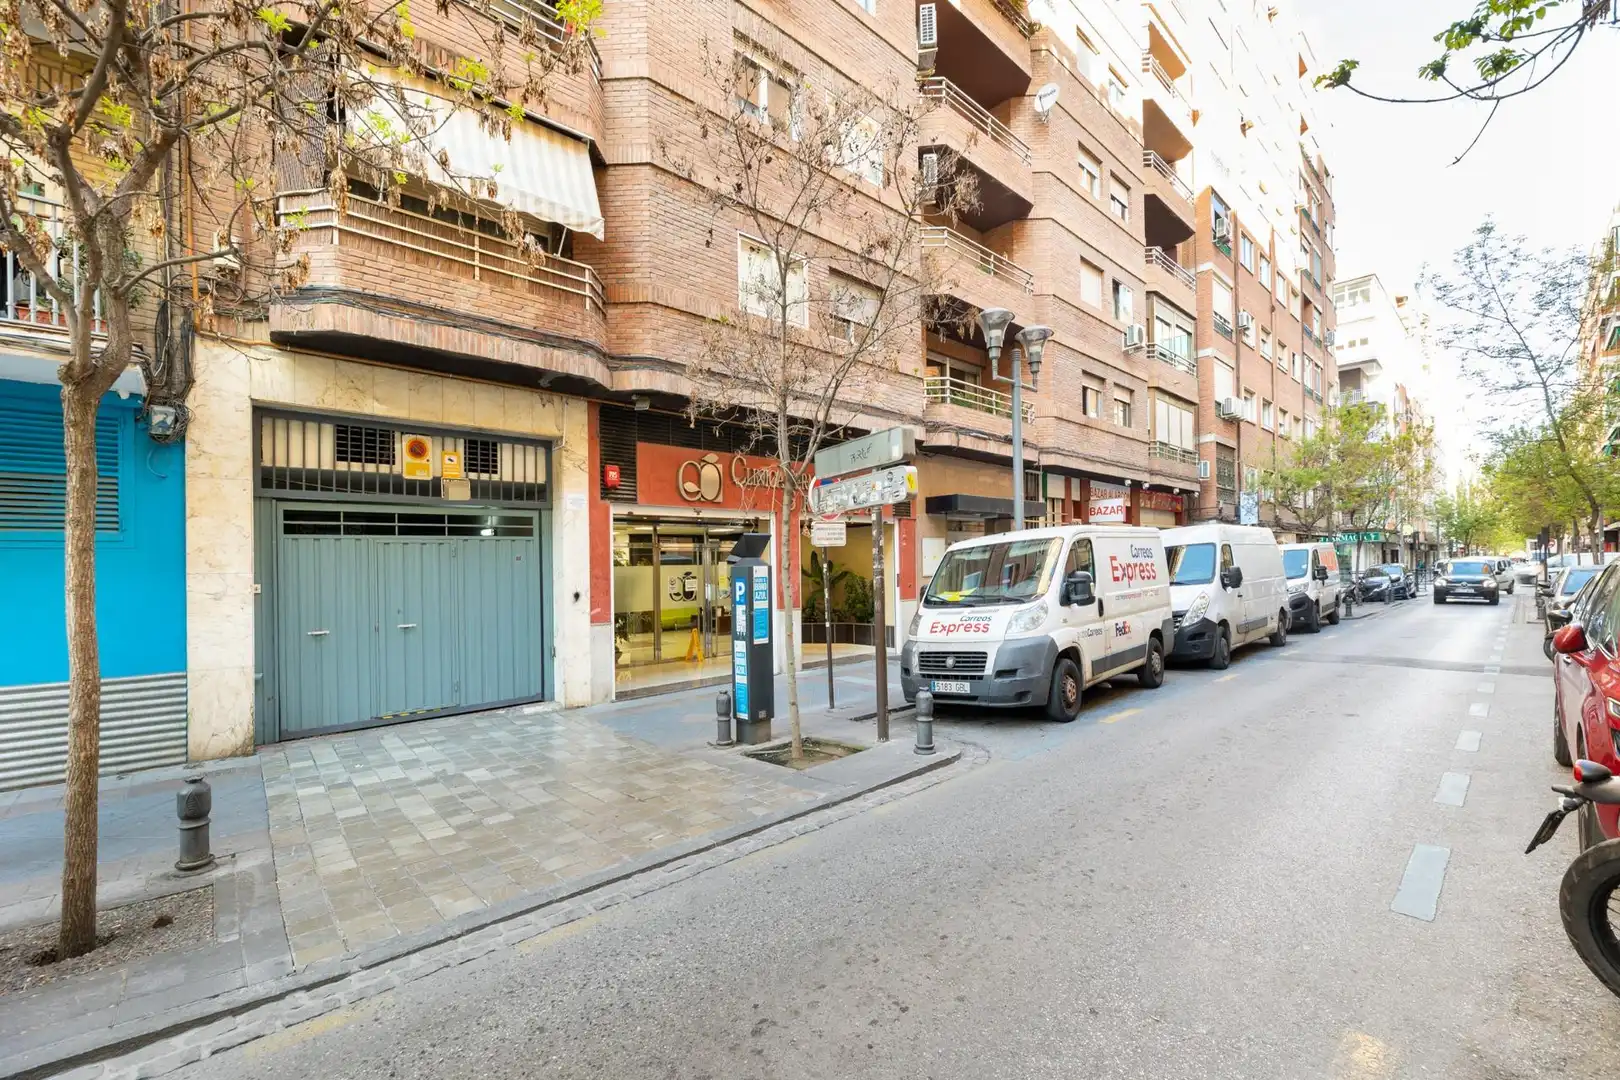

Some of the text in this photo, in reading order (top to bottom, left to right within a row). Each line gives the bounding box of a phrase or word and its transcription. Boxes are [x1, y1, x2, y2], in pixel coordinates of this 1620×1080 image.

[1089, 505, 1123, 516] BAZAR
[1130, 544, 1153, 559] Correos
[1109, 556, 1157, 588] Express
[735, 581, 746, 602] P
[930, 621, 990, 636] Express
[1115, 621, 1131, 637] FedEx
[936, 682, 968, 692] 5183 GBL
